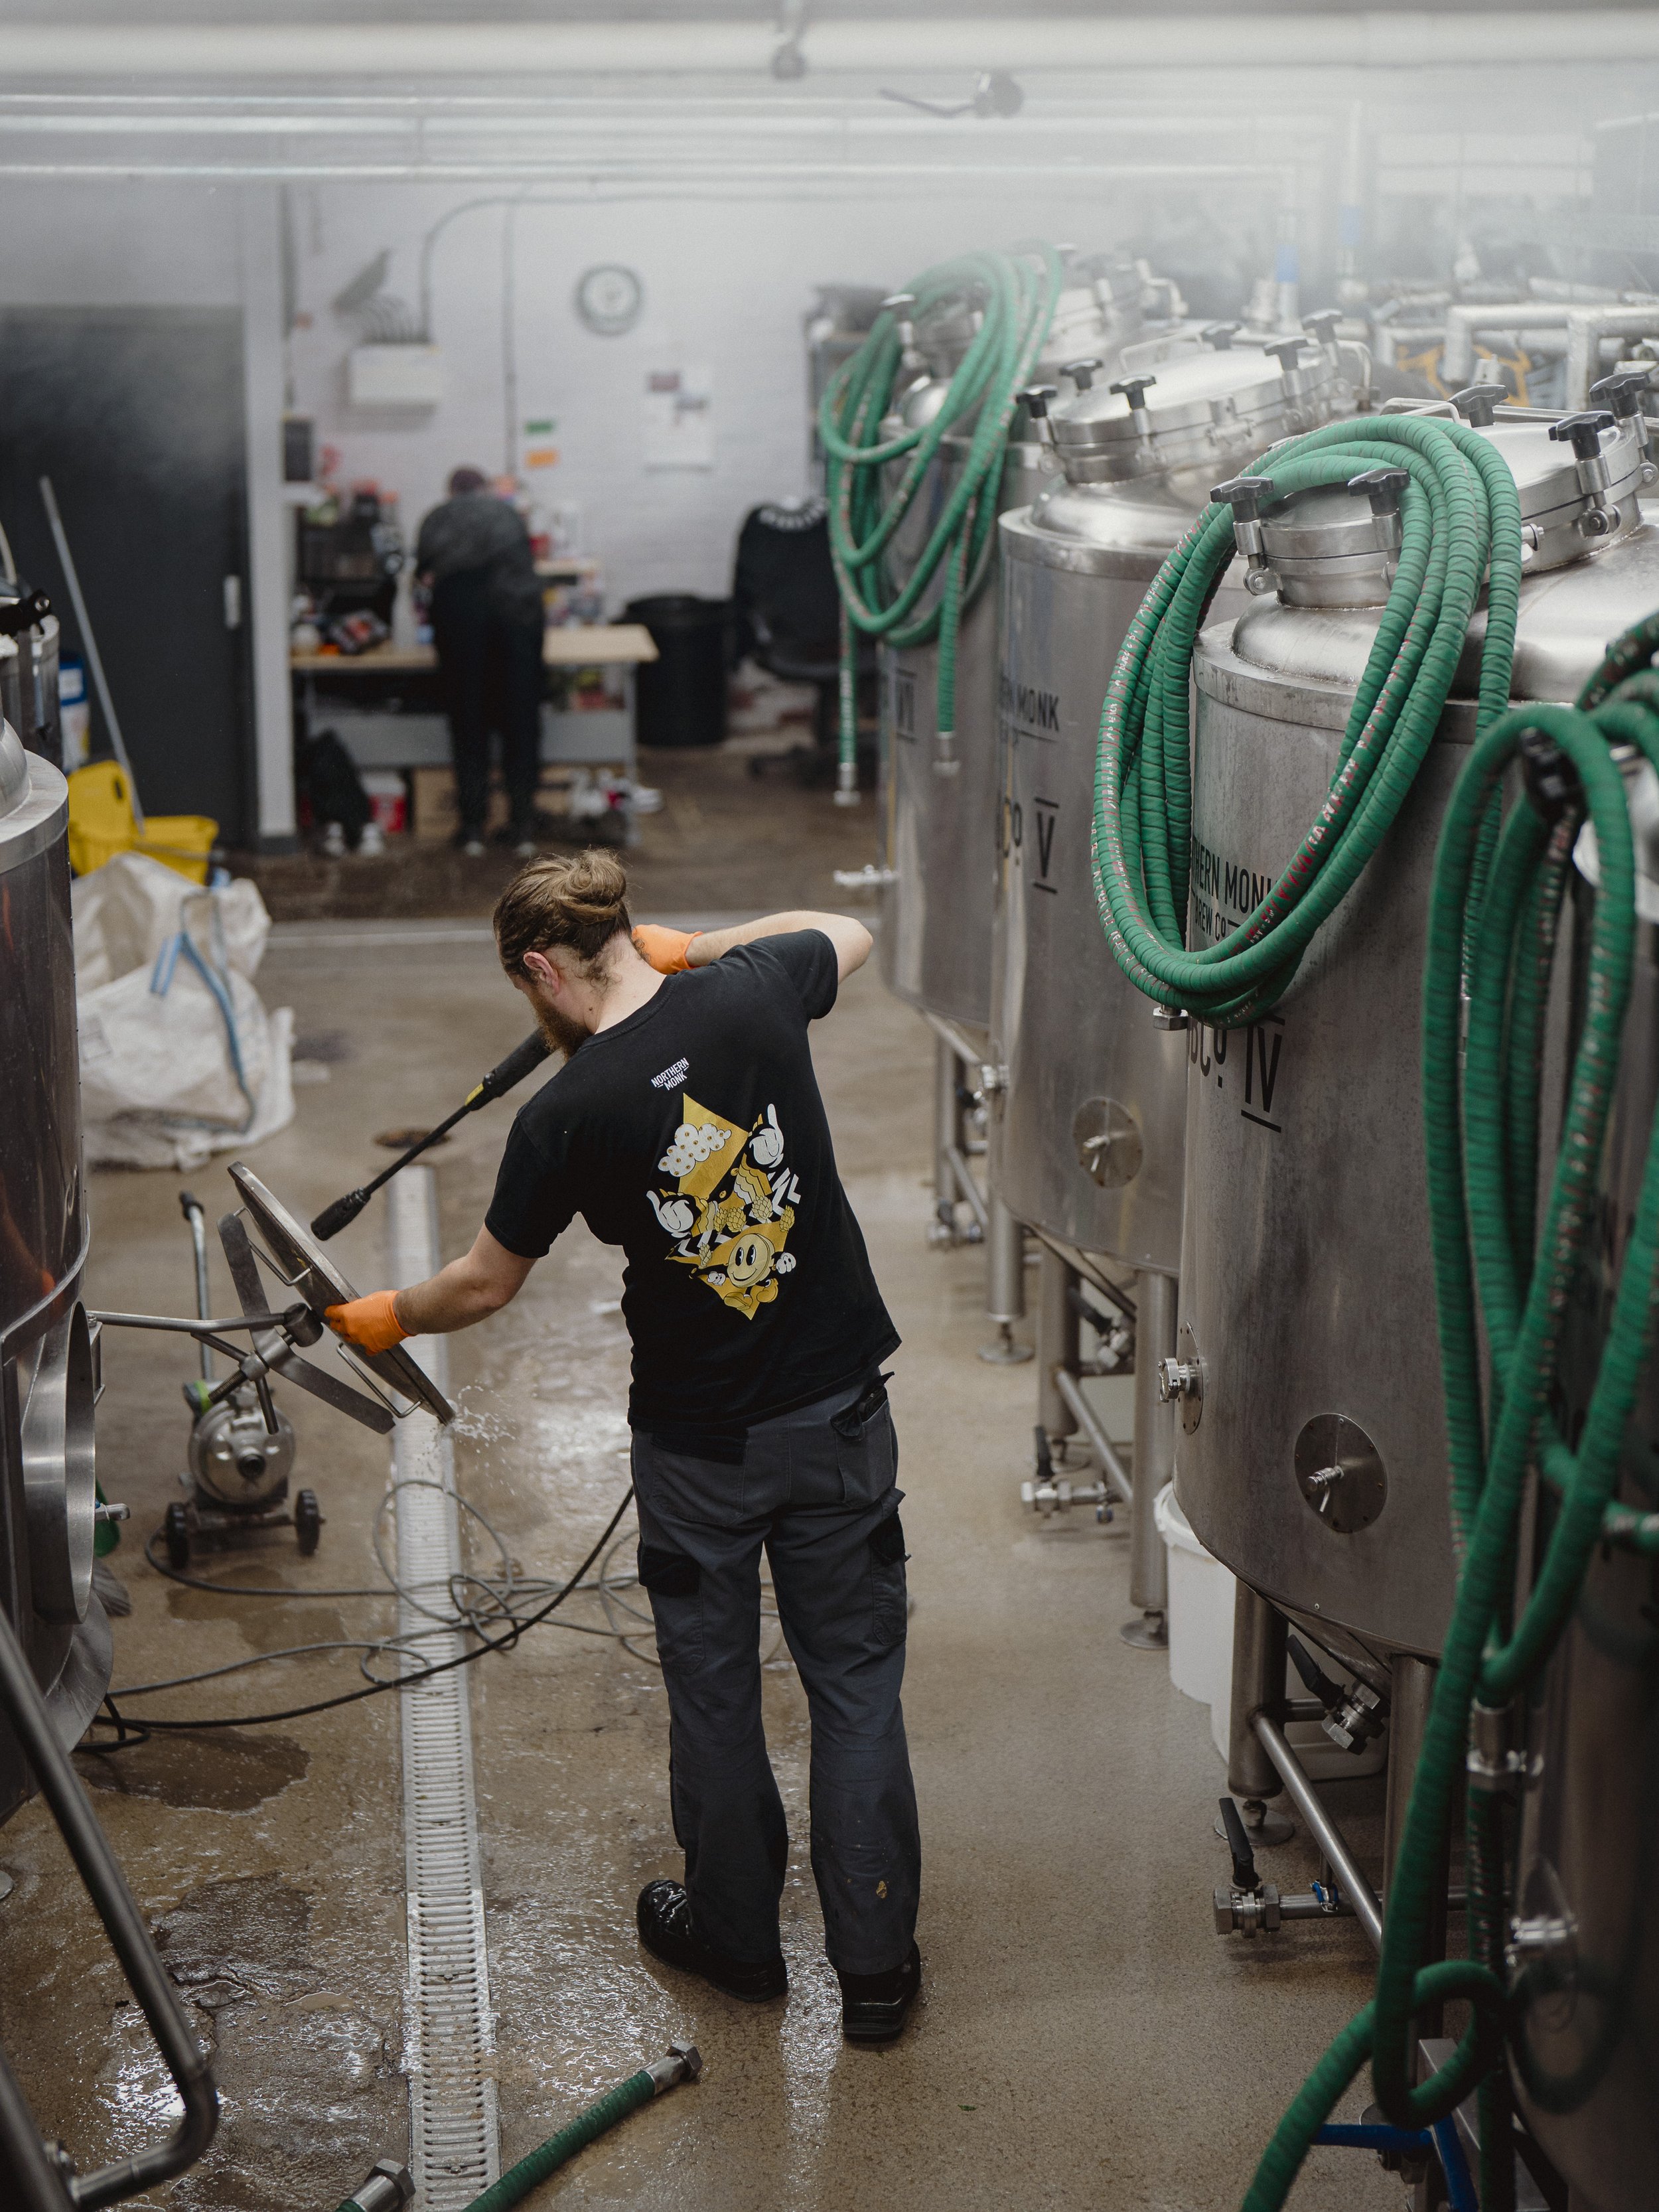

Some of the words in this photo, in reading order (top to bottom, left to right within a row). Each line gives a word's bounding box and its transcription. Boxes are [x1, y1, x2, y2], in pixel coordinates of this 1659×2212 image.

[1017, 684, 1059, 732] MONK
[1035, 805, 1056, 883] V
[1224, 861, 1278, 914] MON
[1194, 895, 1213, 937] BREW
[650, 1057, 690, 1088] NORTHERN
[664, 1070, 688, 1091] MONK
[1244, 1019, 1284, 1115] IV
